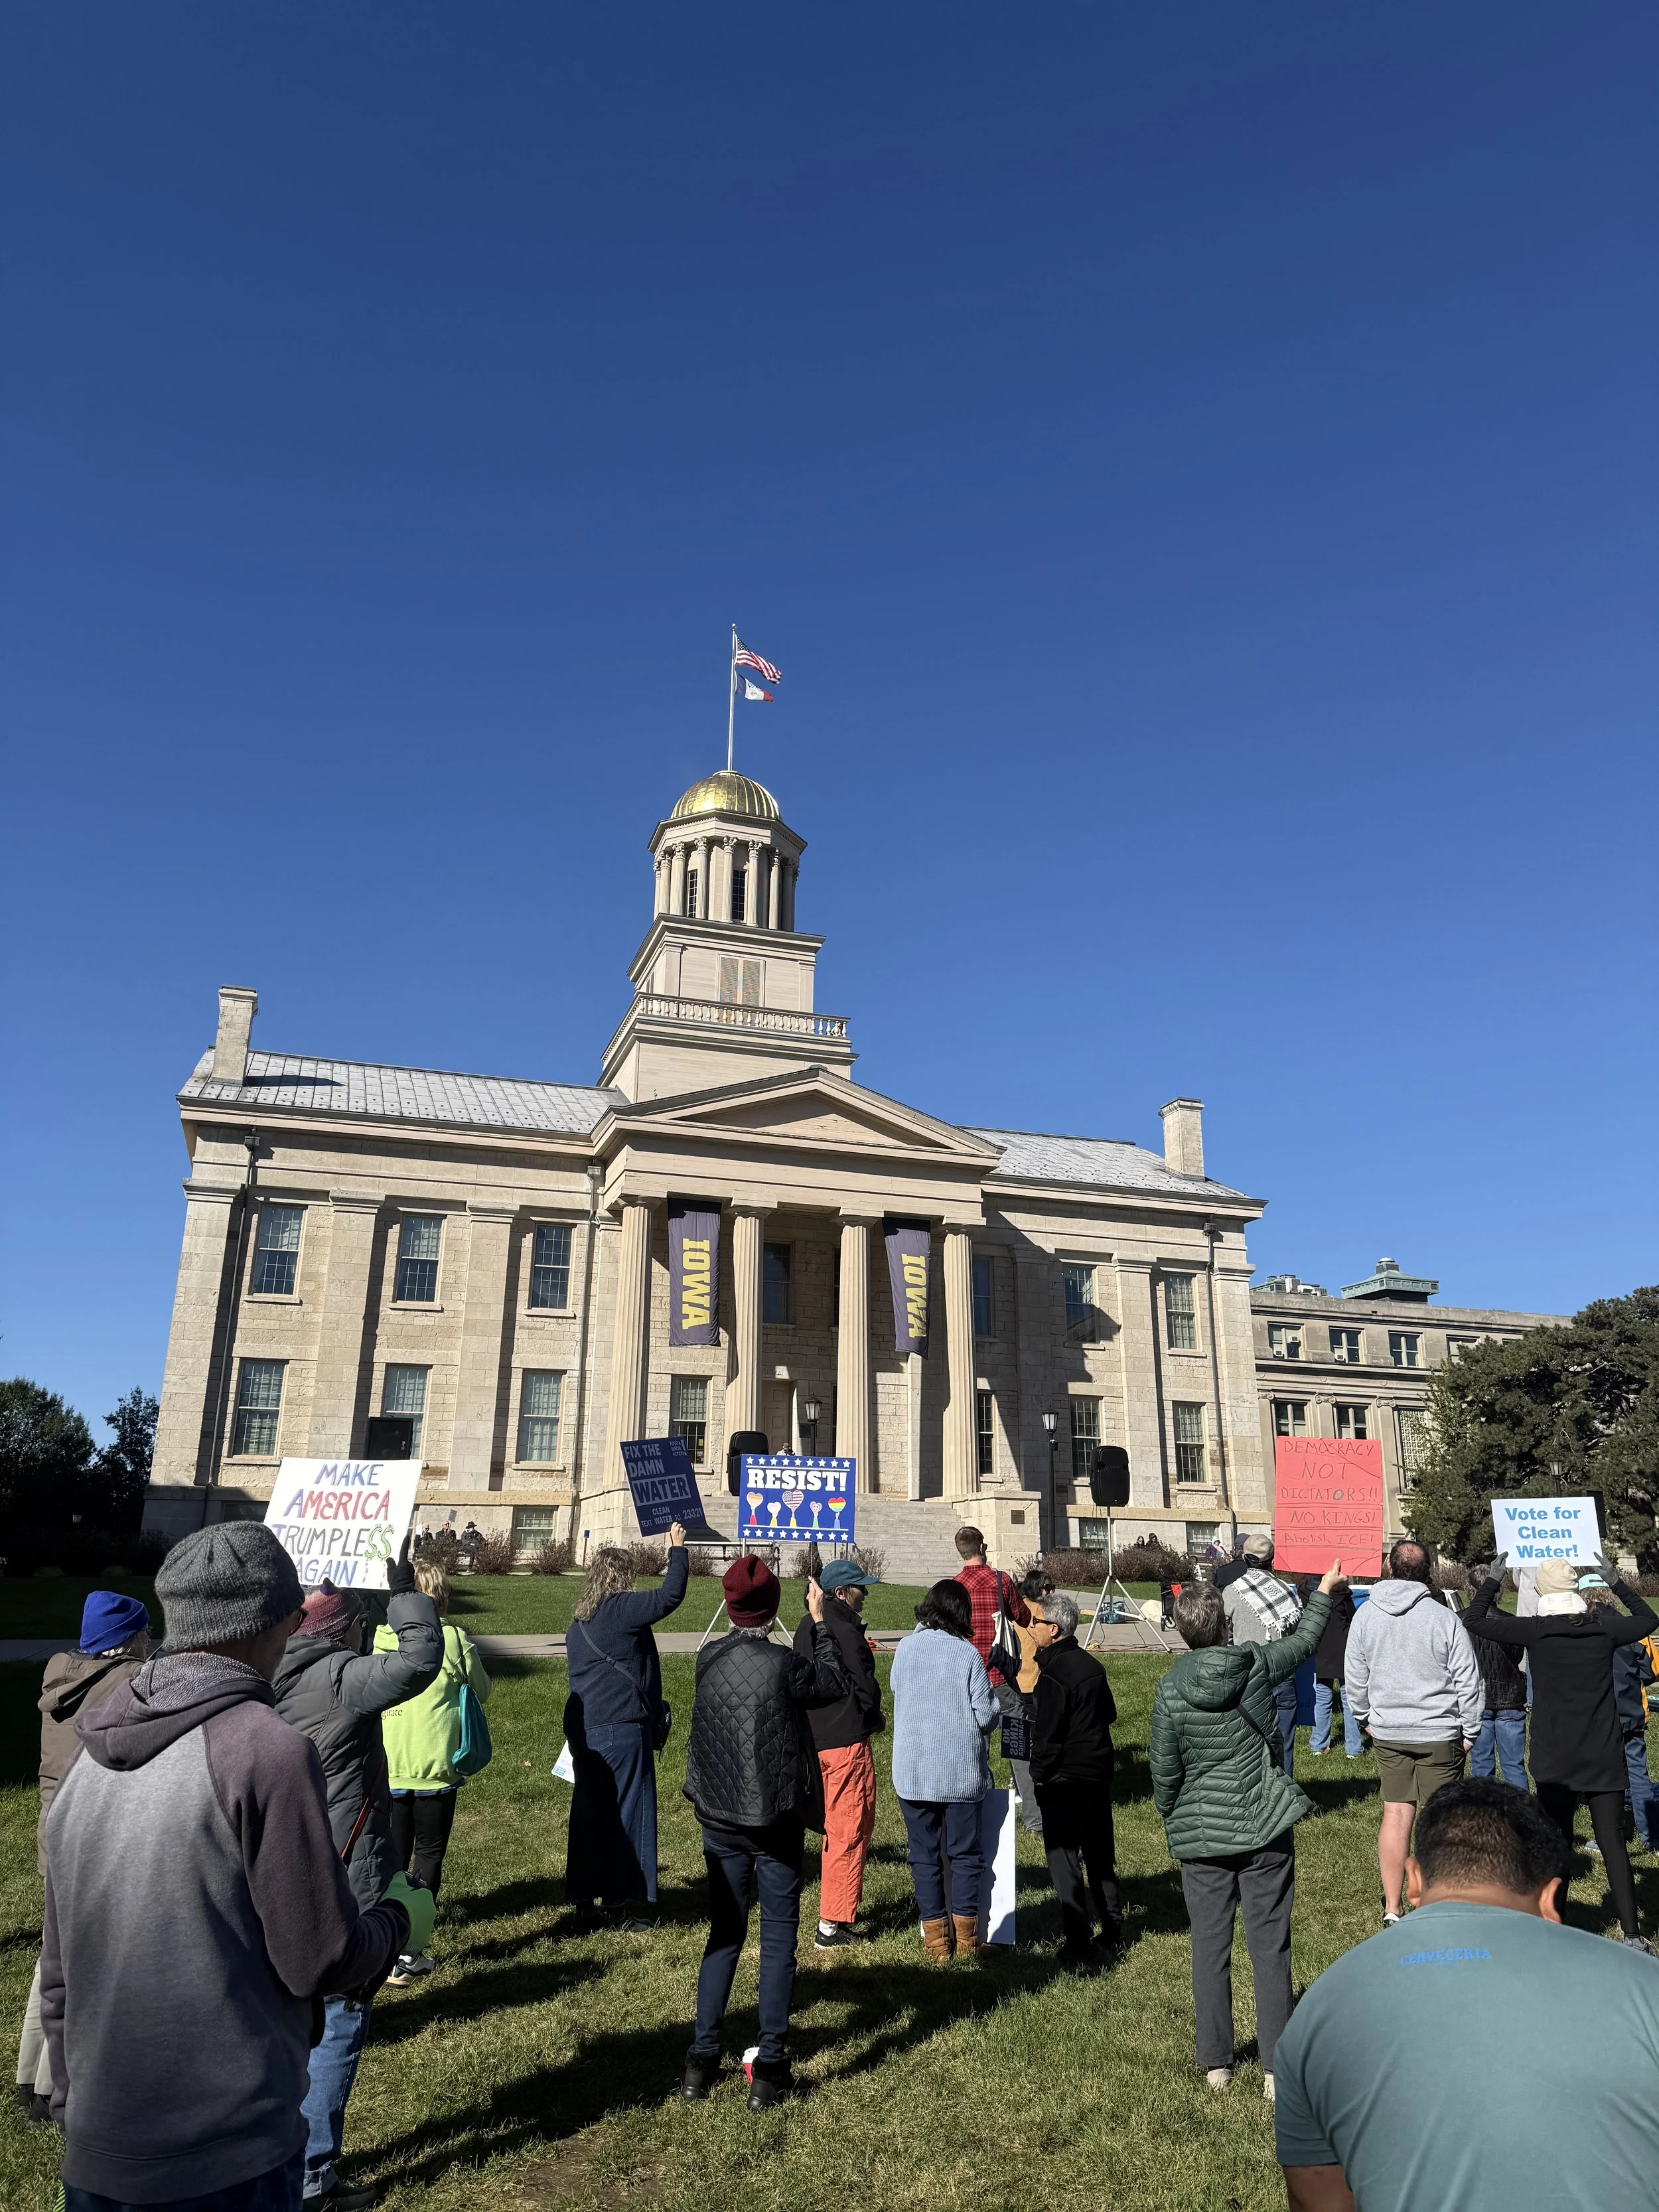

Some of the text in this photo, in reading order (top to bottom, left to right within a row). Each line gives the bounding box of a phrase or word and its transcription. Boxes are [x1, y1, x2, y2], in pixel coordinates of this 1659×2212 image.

[682, 1238, 710, 1330] IOWA
[901, 1253, 927, 1339] IOWA
[624, 1443, 662, 1459] FIX THE
[1284, 1440, 1374, 1457] DEMOCRACY
[314, 1463, 384, 1486] MAKE
[628, 1459, 665, 1477] DAMN
[1302, 1461, 1353, 1479] NOT
[747, 1469, 847, 1492] RESIST!
[633, 1477, 689, 1503] WATER
[1281, 1487, 1378, 1502] DICTATORS!!
[283, 1489, 390, 1521] AMERICA
[652, 1506, 670, 1516] CLEAN
[1504, 1507, 1581, 1520] Vote for
[654, 1515, 673, 1525] WATER
[683, 1507, 703, 1520] 23321
[1291, 1510, 1376, 1524] NO KINGS!
[1284, 1532, 1374, 1546] Abolish ICE!
[1518, 1526, 1572, 1539] Clean
[1516, 1544, 1579, 1558] Water!
[296, 1557, 358, 1587] AGAIN
